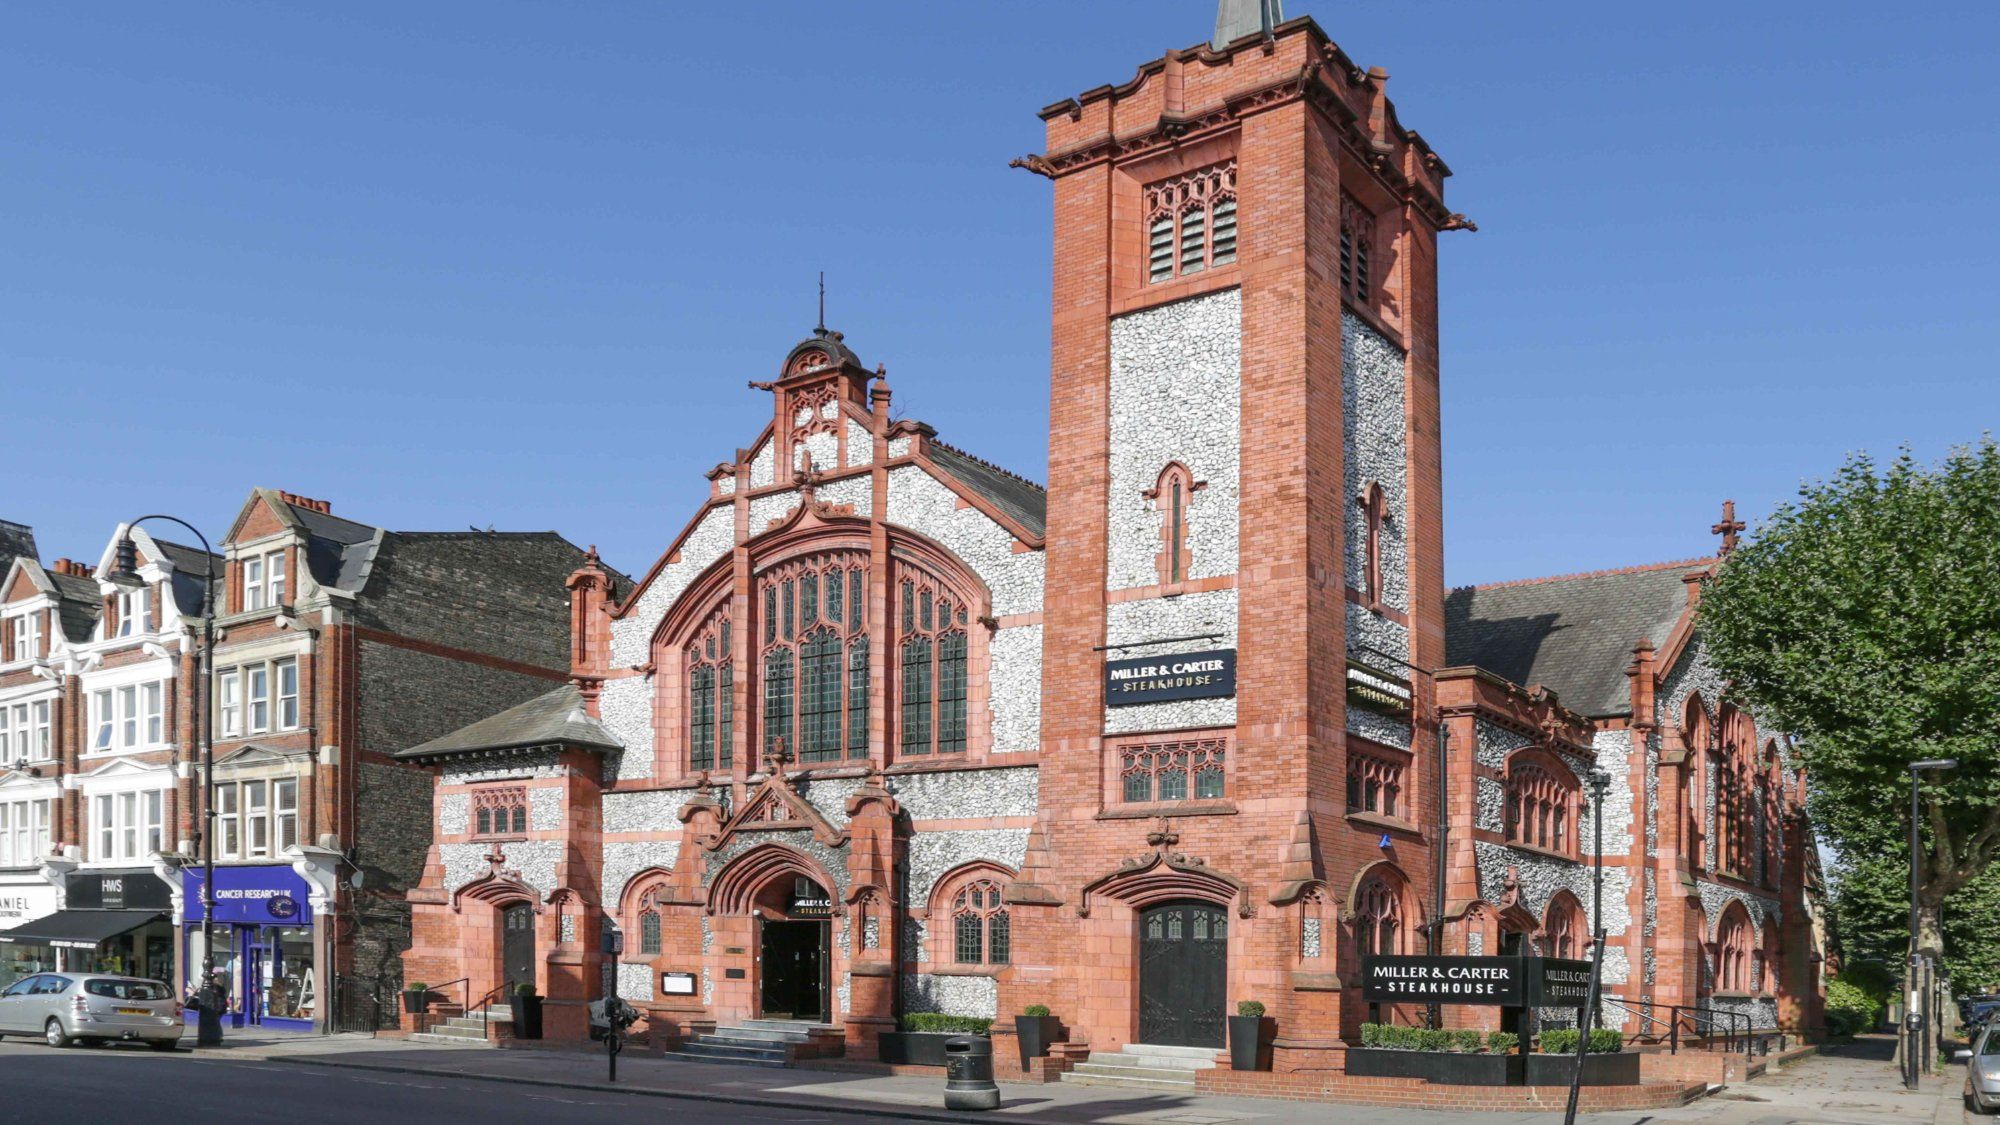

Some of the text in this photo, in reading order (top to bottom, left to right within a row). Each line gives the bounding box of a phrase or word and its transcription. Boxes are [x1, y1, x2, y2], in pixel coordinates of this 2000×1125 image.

[1111, 660, 1224, 680] MILLER & CARTER
[1123, 675, 1211, 692] STEAKHOUSE
[102, 879, 122, 892] HWS
[216, 889, 243, 899] CANCER
[245, 889, 279, 899] RESEARCH
[1374, 966, 1509, 979] MILLER & CARTER
[1546, 969, 1568, 981] MILLER
[1388, 982, 1494, 994] STEAKHOUSE
